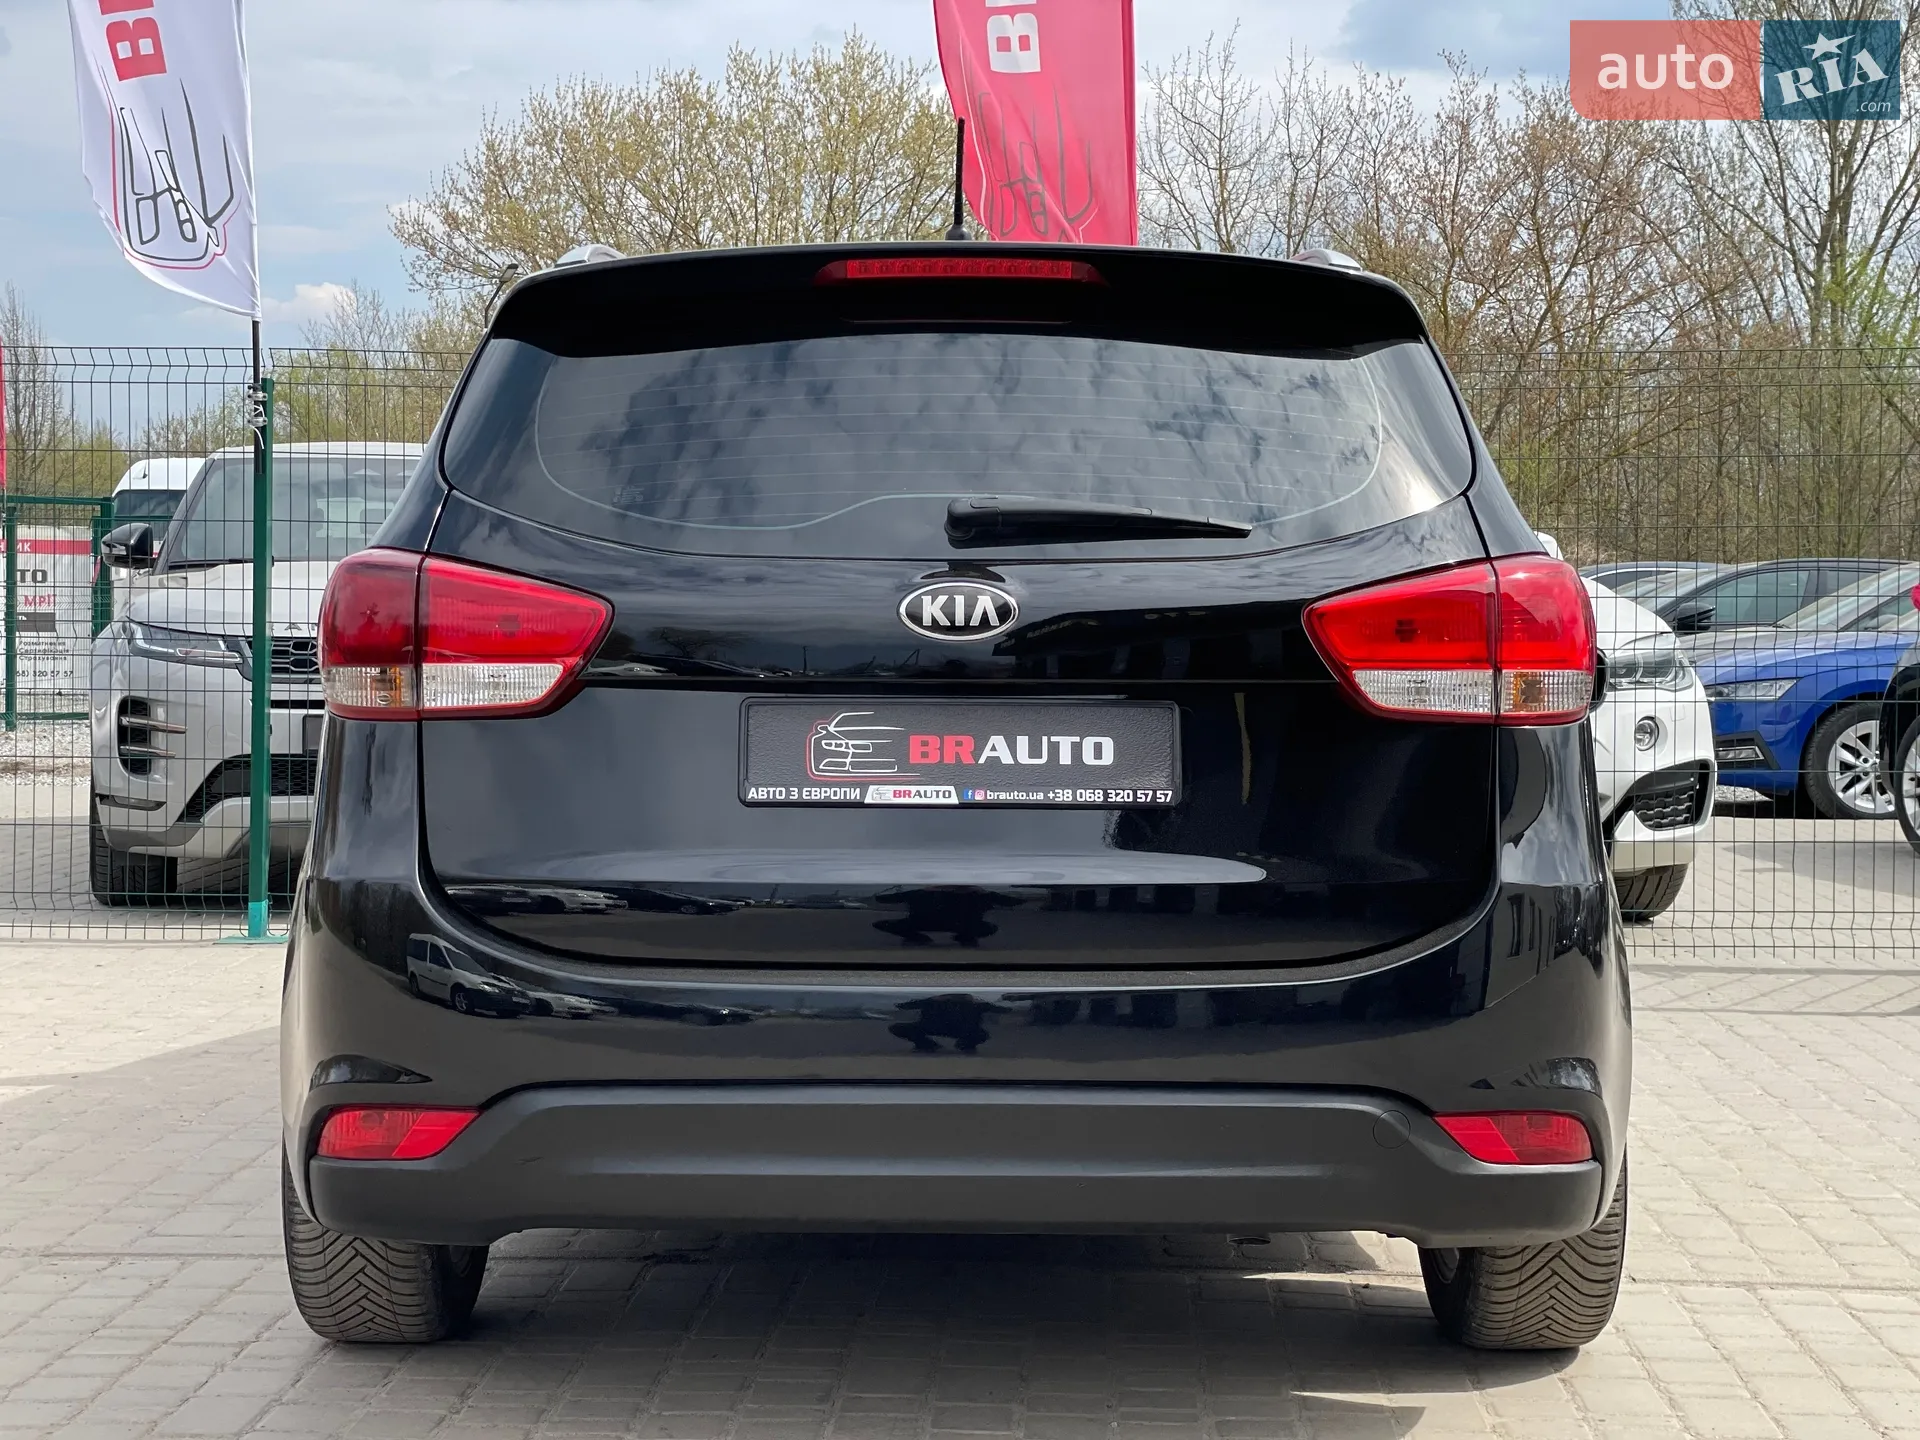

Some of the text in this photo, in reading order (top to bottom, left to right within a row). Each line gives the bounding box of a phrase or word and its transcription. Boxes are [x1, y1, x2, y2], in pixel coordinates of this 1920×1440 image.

[98, 0, 167, 82] B
[985, 0, 1041, 73] B
[921, 595, 1000, 626] KIA
[909, 735, 1114, 766] BRAUTO
[747, 787, 786, 800] АВТО
[802, 787, 861, 800] ЄВРОПИ
[892, 789, 952, 799] BRAUTO
[986, 789, 1173, 802] brauto.ua +38 068 320 57 57
